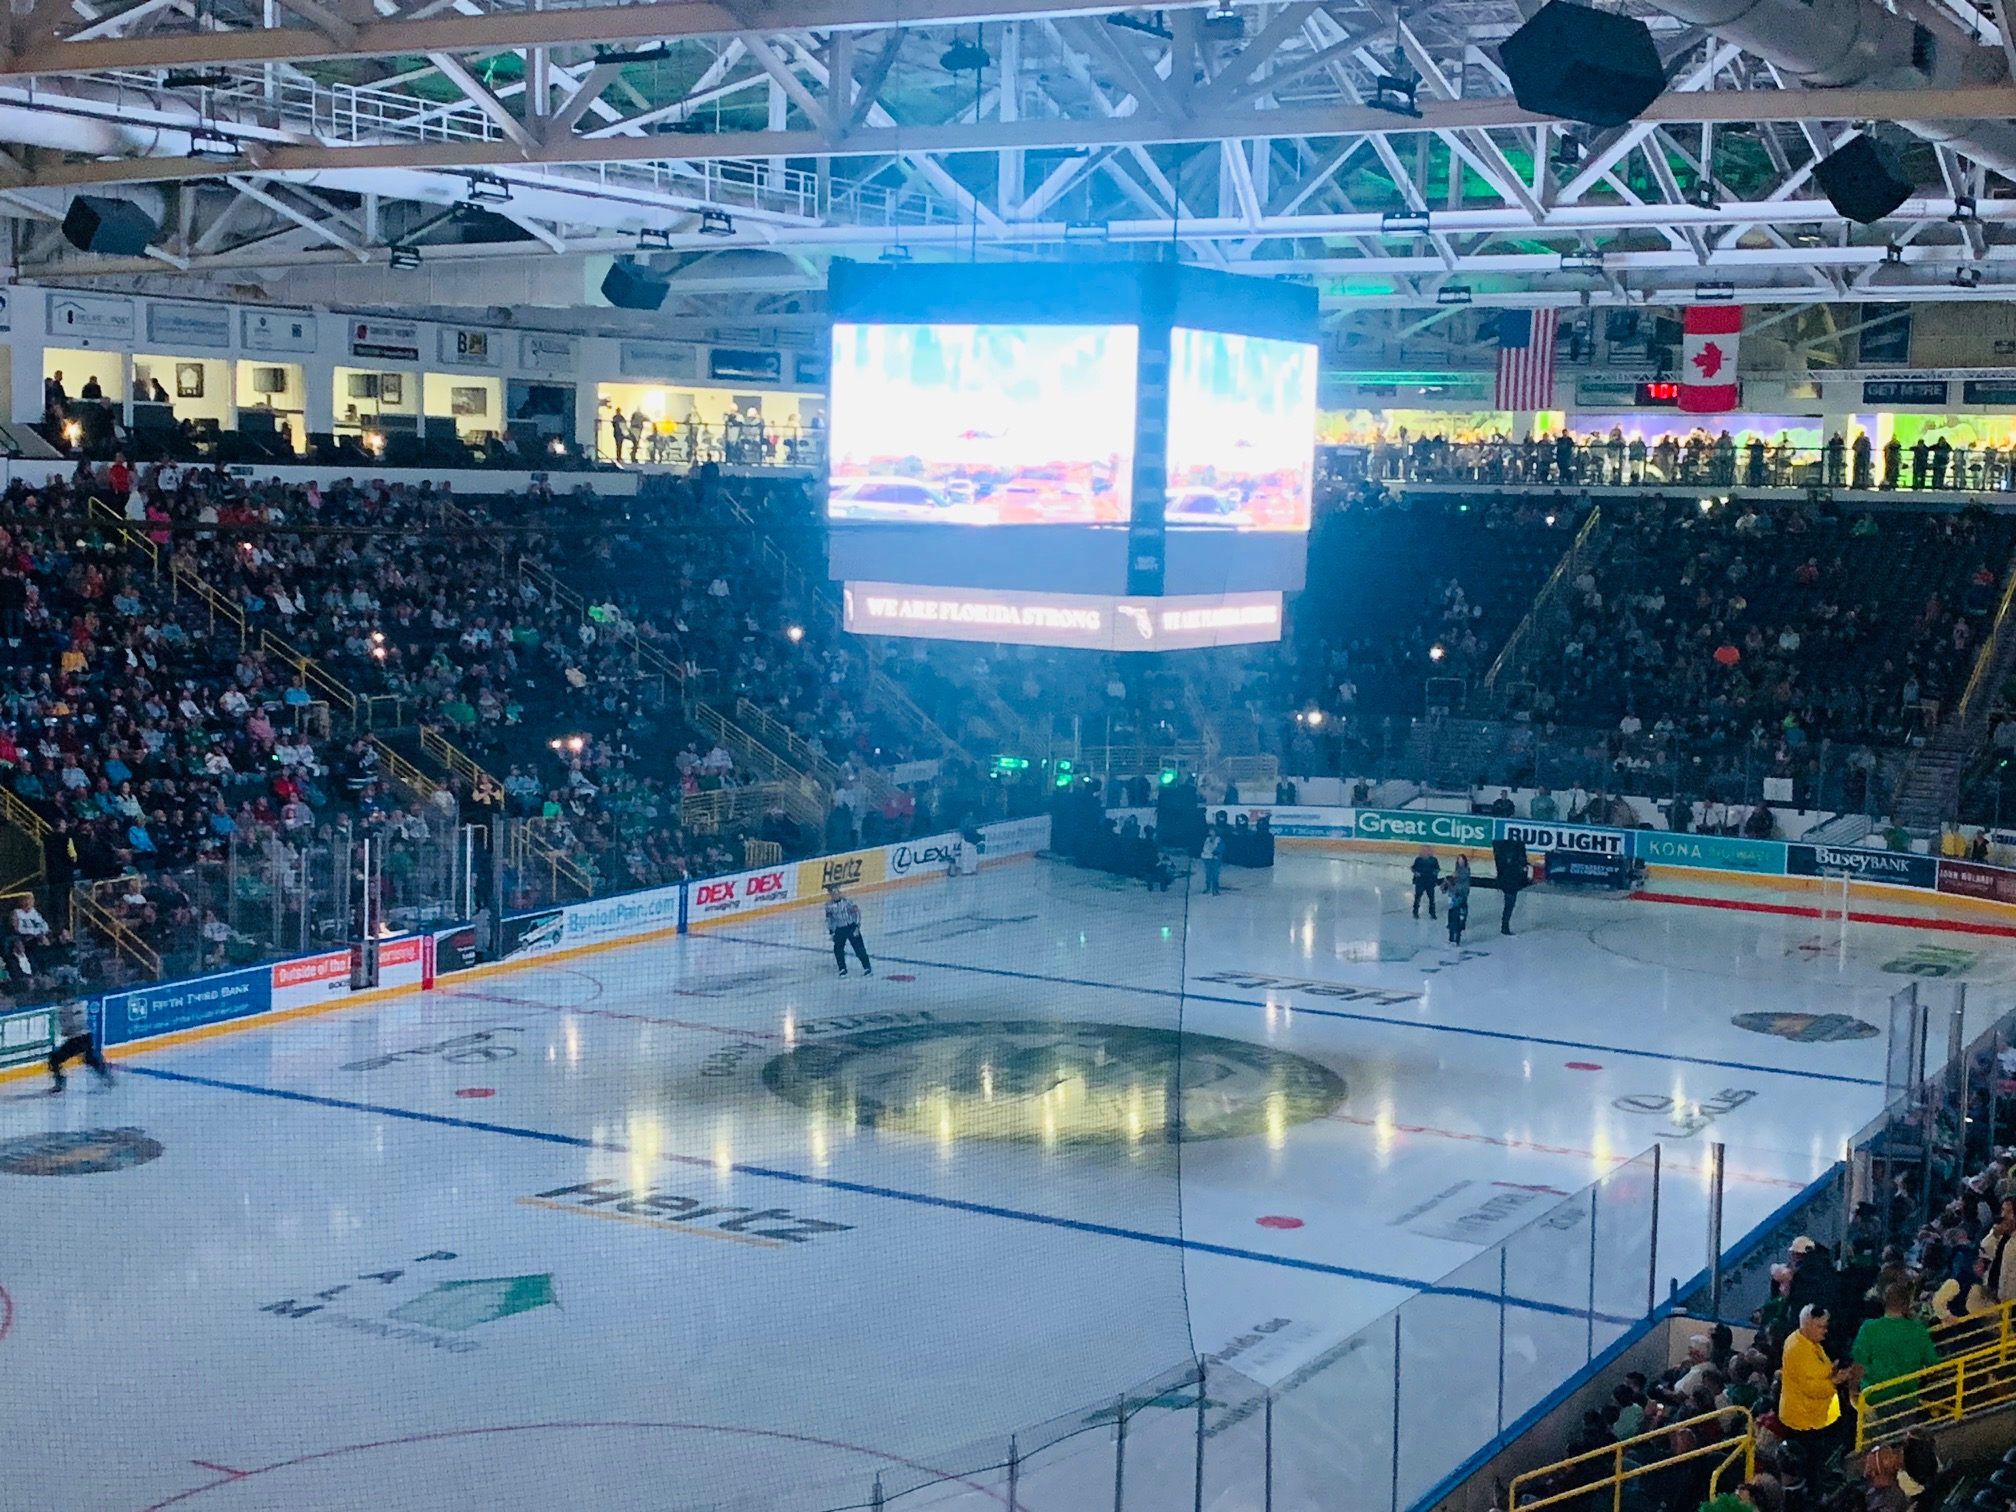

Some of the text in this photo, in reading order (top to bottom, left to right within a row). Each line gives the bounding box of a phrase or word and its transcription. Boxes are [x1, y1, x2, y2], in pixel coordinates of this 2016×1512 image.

[866, 597, 1101, 630] WE ARE FLORIDA STRONG
[1358, 812, 1427, 836] Great
[1431, 817, 1485, 843] Clips
[1508, 827, 1622, 853] BUD LIGHT
[1649, 840, 1702, 859] KONA
[822, 858, 863, 884] Hertz
[696, 880, 736, 906] DEX
[746, 871, 785, 896] DEX
[704, 889, 788, 912] imaging imaging
[279, 963, 317, 983] Outside
[317, 961, 329, 976] of
[329, 958, 346, 973] the
[187, 989, 219, 1005] THIRD
[221, 984, 250, 998] BANK
[1190, 971, 1424, 1006] Hertz
[534, 1178, 859, 1244] Hertz
